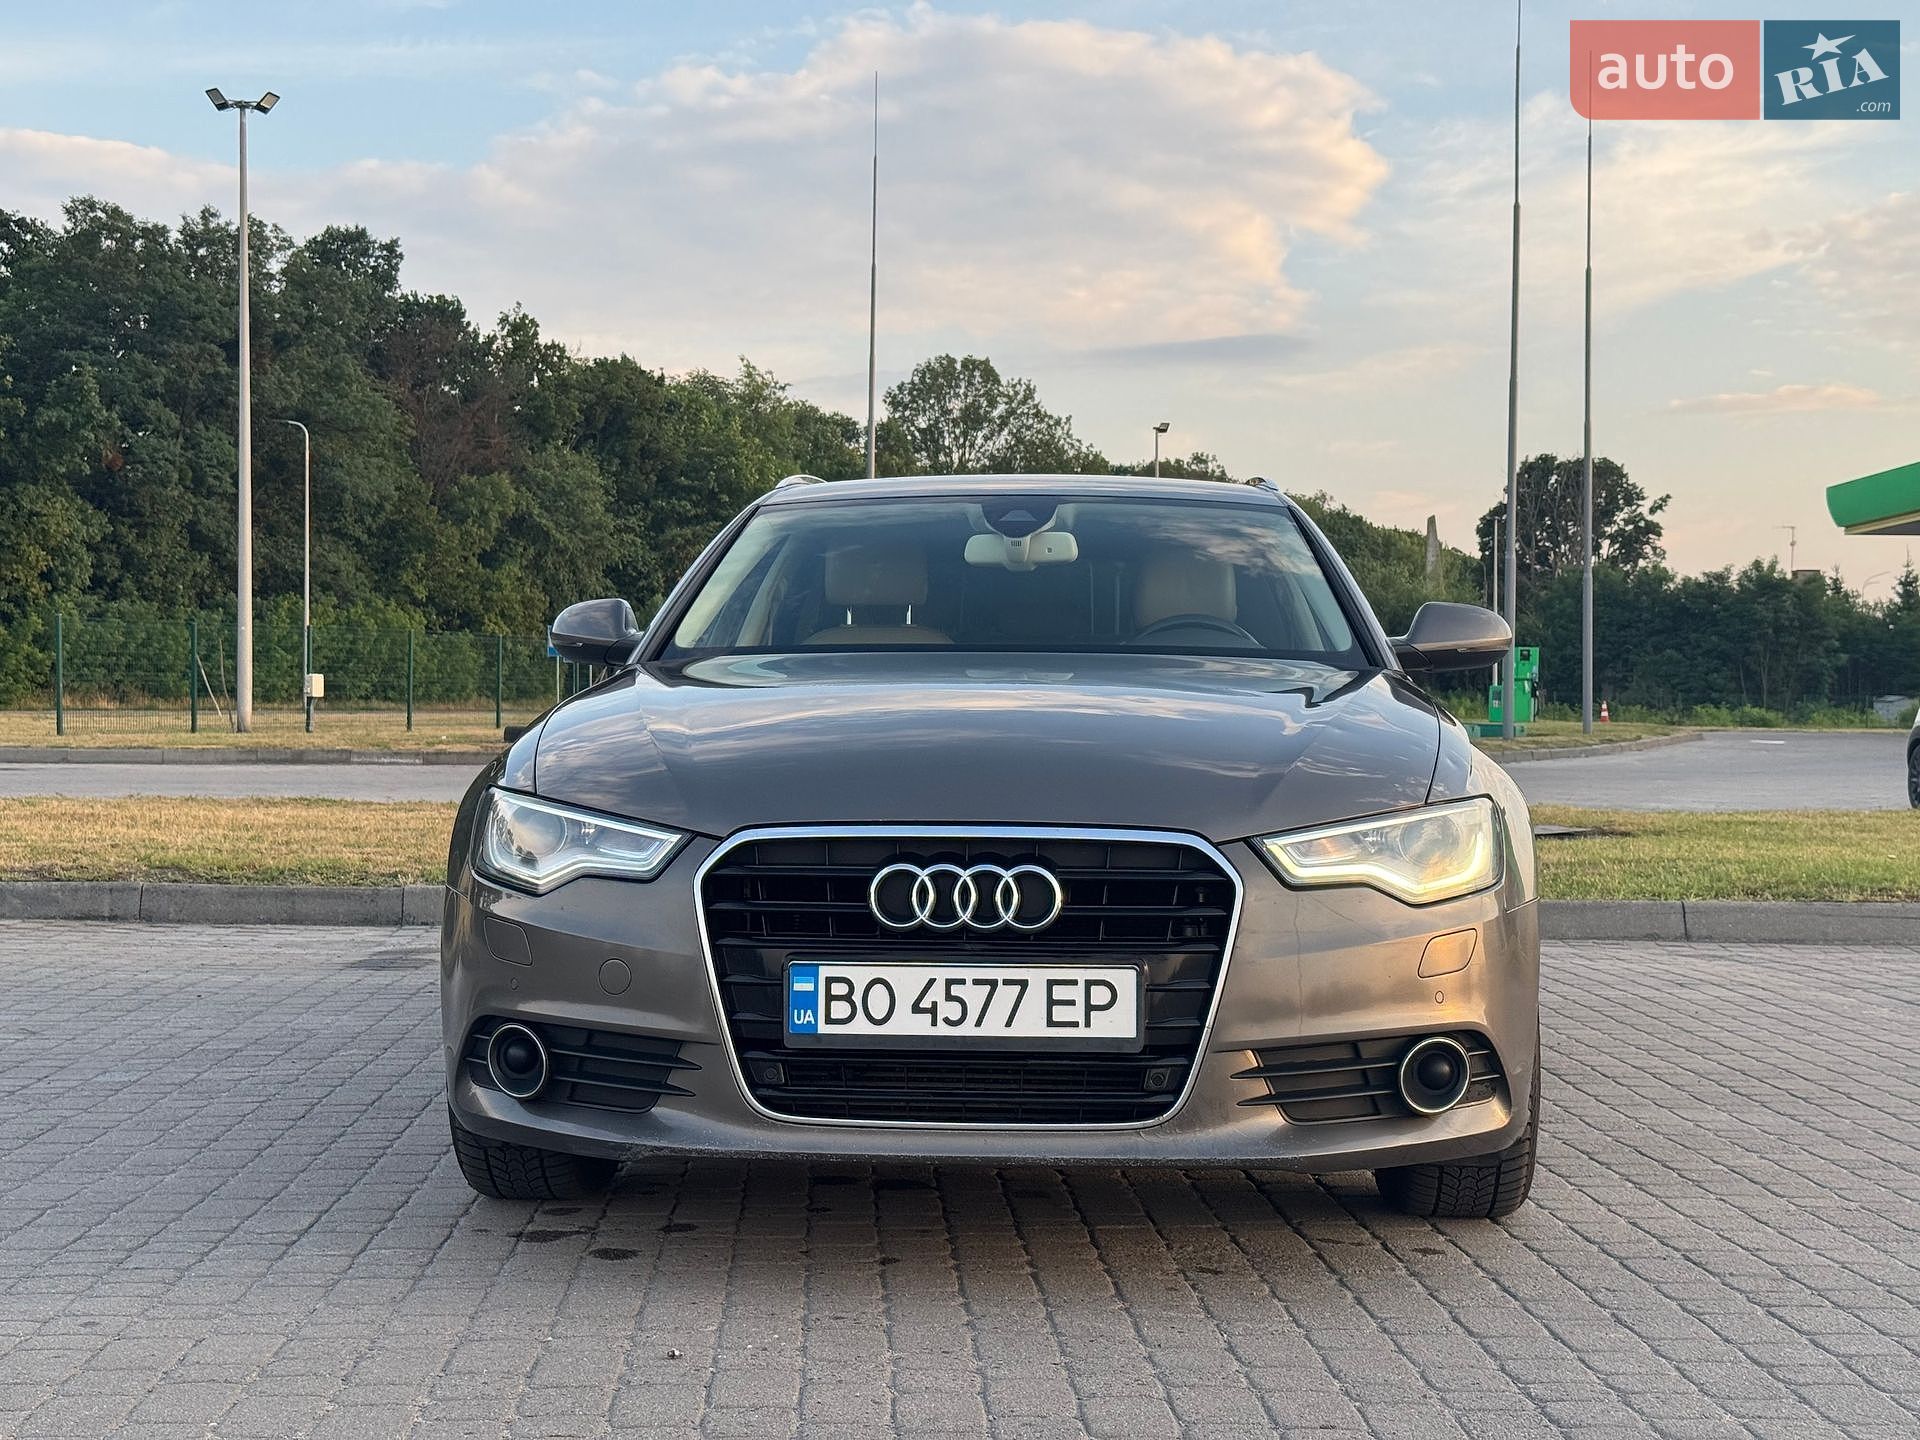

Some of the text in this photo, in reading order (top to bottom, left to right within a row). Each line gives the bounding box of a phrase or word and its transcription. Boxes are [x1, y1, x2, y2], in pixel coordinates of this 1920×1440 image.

[794, 1010, 815, 1025] UA
[824, 976, 1118, 1028] BO 4577 EP
